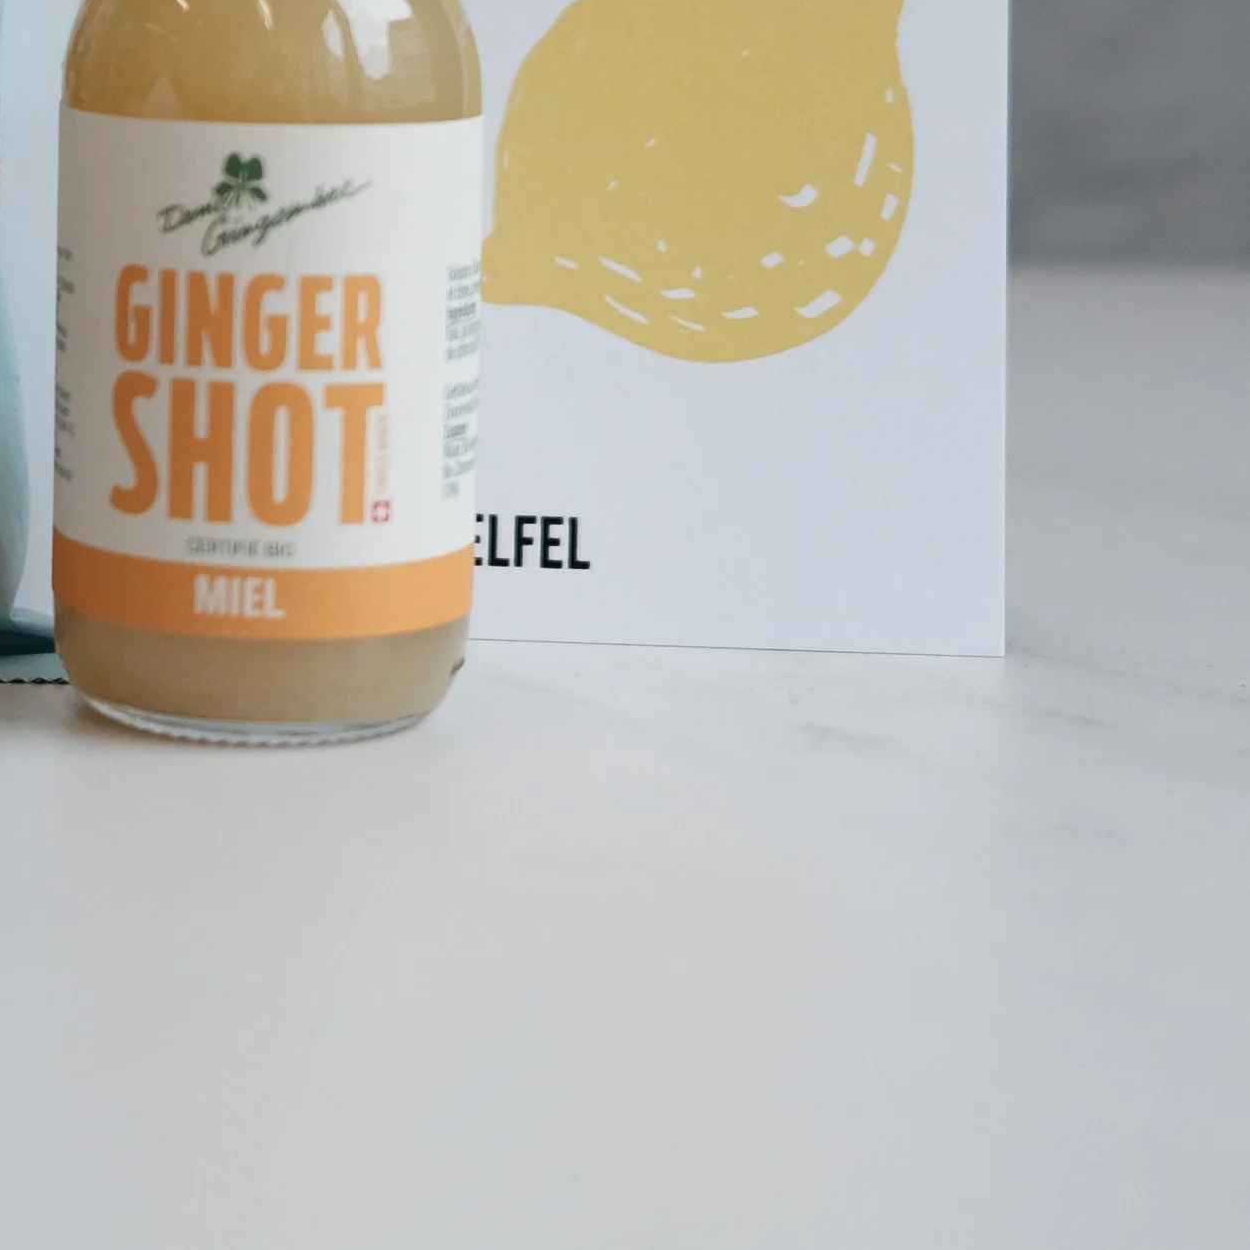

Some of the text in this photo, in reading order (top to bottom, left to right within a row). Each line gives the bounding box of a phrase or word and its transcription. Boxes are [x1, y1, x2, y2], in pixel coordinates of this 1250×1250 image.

[114, 264, 385, 372] GINGER
[109, 370, 386, 527] SHOT
[194, 573, 287, 619] MIEL
